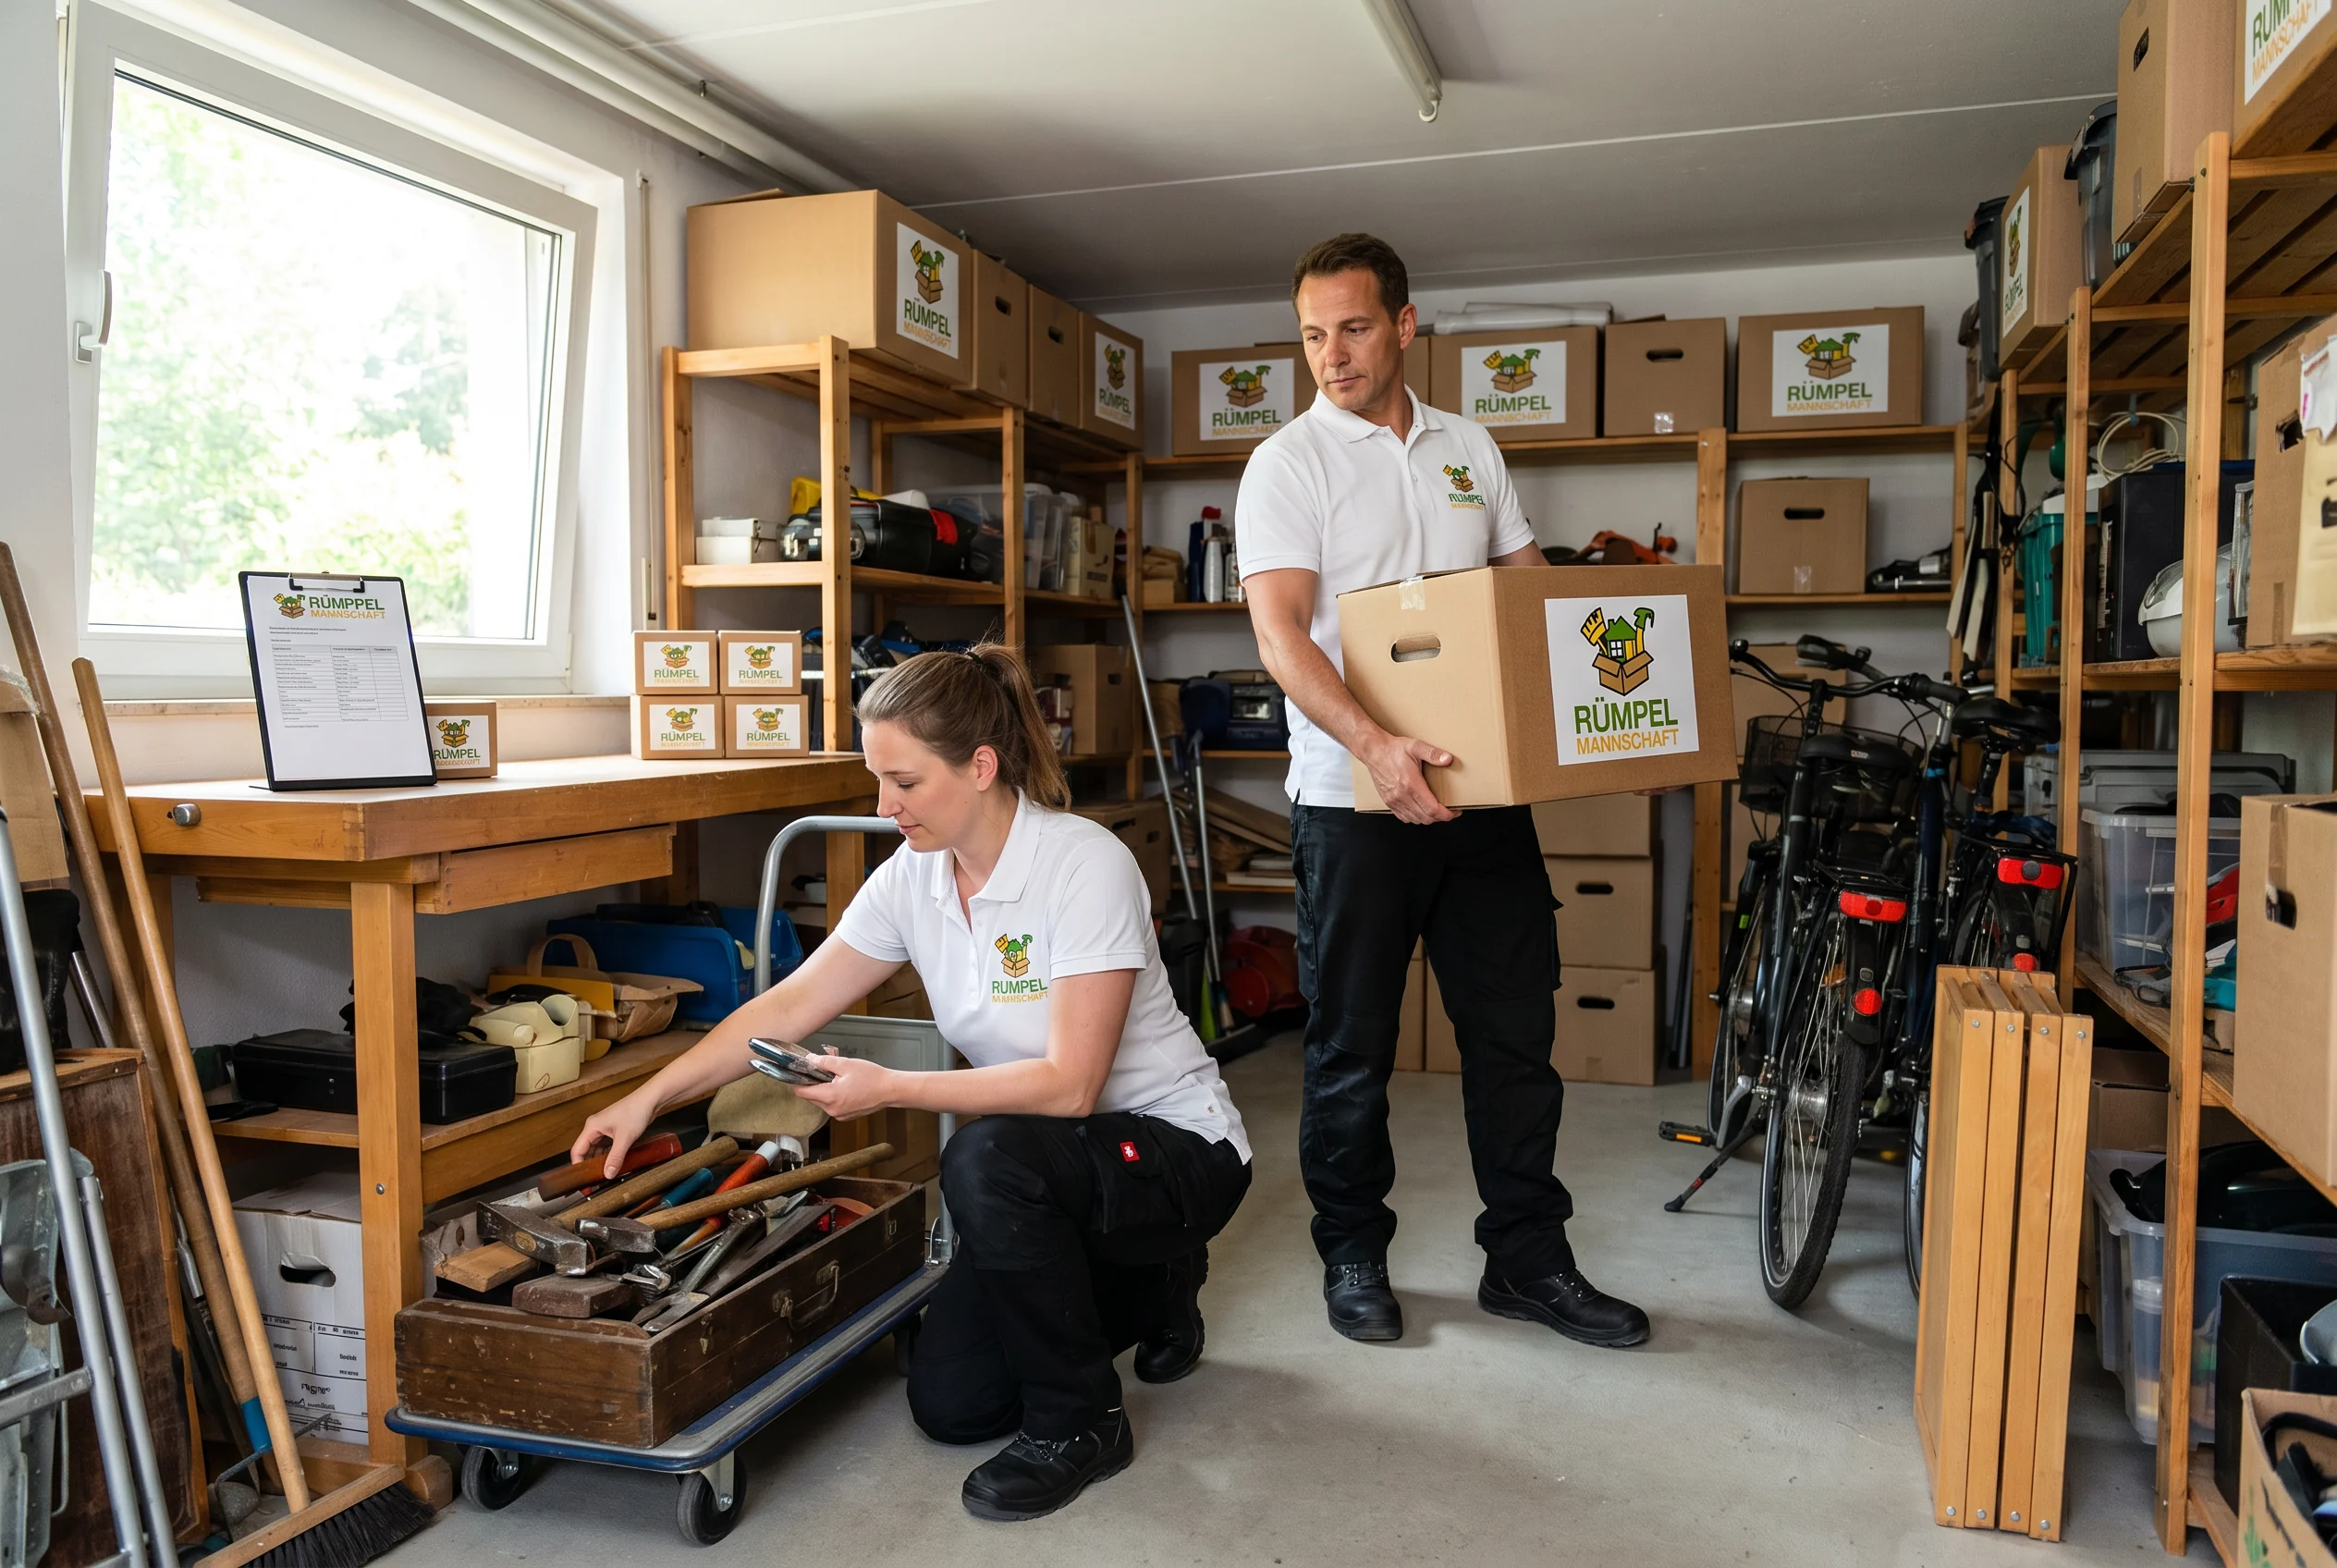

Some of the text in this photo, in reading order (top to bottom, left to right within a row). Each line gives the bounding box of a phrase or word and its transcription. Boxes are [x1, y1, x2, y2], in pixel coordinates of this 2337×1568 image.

[904, 297, 951, 337] RÜMPEL
[1787, 381, 1873, 401] RÜMPEL
[1474, 394, 1552, 414] RÜMPEL
[1786, 398, 1873, 413] MANNSCHAFT
[1212, 408, 1282, 426] RÜMPEL
[309, 594, 385, 611] RÜMPPEL
[310, 608, 386, 620] MANNSCHAFT
[739, 668, 783, 679] RÜMPEL
[1573, 696, 1679, 735] RÜMPEL
[660, 731, 705, 741] RÜMPEL
[746, 730, 790, 741] RÜMPEL
[1576, 728, 1680, 755] MANNSCHAFT
